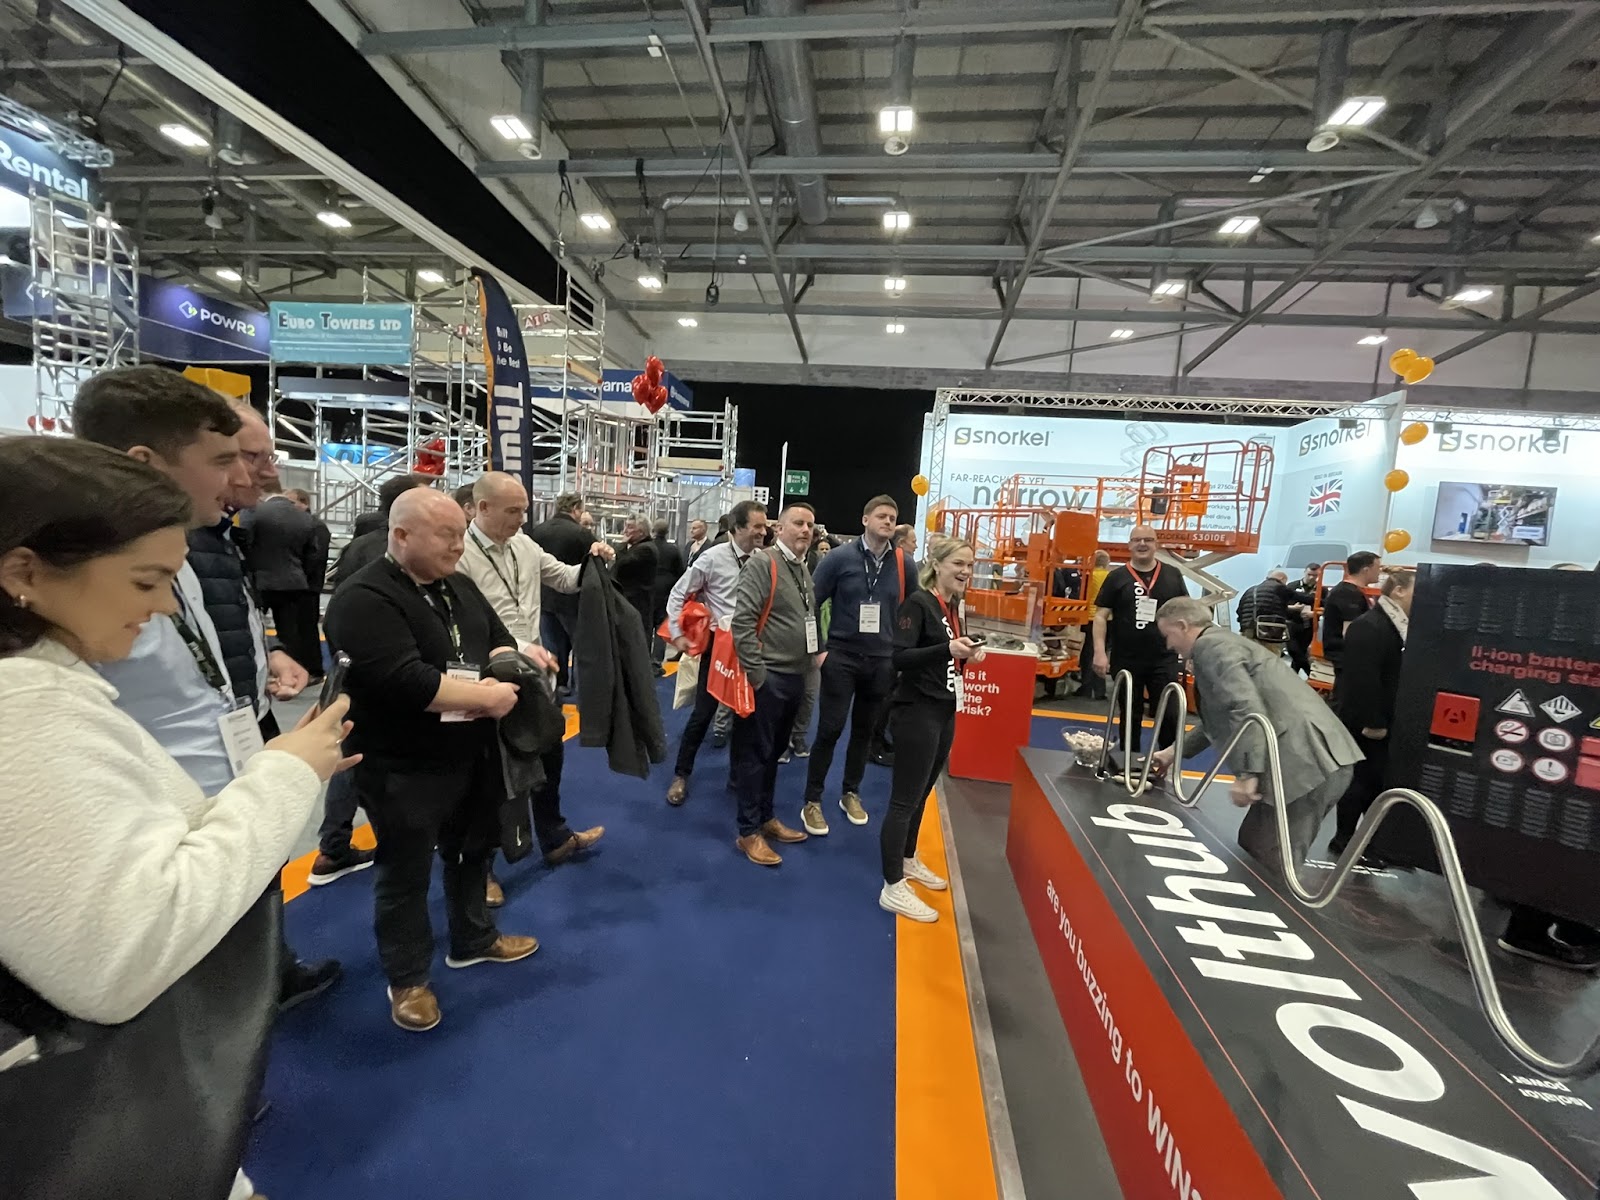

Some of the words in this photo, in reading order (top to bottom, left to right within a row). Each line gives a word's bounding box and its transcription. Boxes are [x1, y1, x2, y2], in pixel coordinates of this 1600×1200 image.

[0, 140, 88, 201] Rental
[200, 308, 255, 337] POWR2
[320, 312, 376, 330] TOWERS
[380, 319, 401, 330] LTD
[973, 430, 1050, 446] snorkel
[1311, 418, 1372, 451] snorkel
[1464, 433, 1569, 454] snorkel
[950, 473, 1026, 485] FAR-REACHG
[1192, 533, 1226, 542] S3010E
[1528, 651, 1600, 672] batter
[965, 669, 976, 680] is
[978, 670, 987, 681] it
[1469, 660, 1561, 684] charging
[1567, 673, 1600, 687] sta
[964, 682, 1000, 694] worth
[963, 692, 983, 704] the
[962, 704, 992, 716] risk?
[1046, 878, 1060, 914] are
[1058, 905, 1077, 954] you
[1075, 939, 1123, 1065] buzzing
[1125, 1047, 1143, 1103] to
[1512, 1075, 1572, 1093] power
